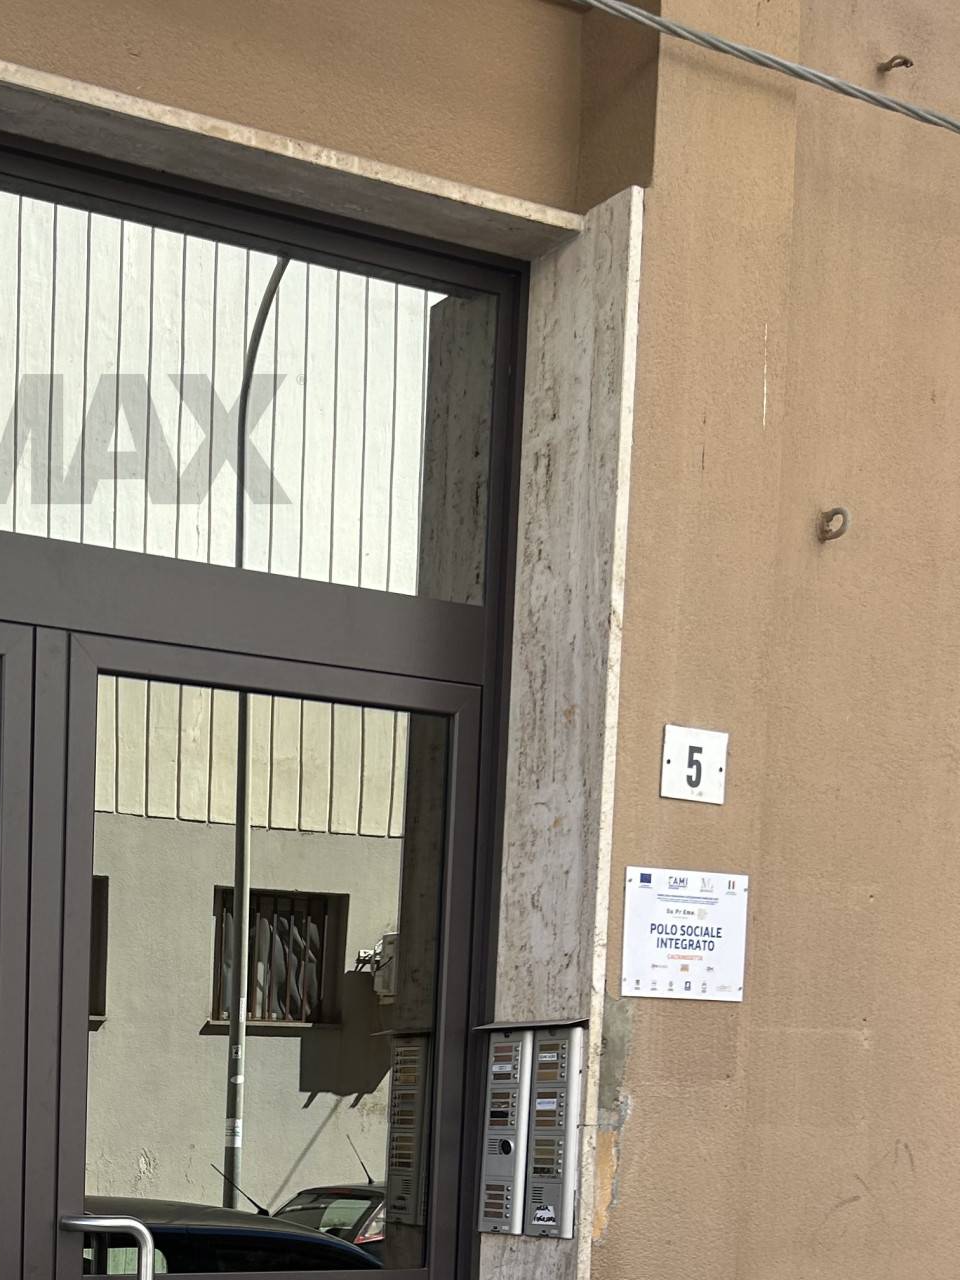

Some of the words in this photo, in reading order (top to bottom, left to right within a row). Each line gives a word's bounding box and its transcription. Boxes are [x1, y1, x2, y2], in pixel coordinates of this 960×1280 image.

[686, 745, 703, 788] 5
[650, 923, 678, 936] POLO
[680, 924, 723, 939] SOCIALE
[656, 937, 715, 952] INTEGRATO
